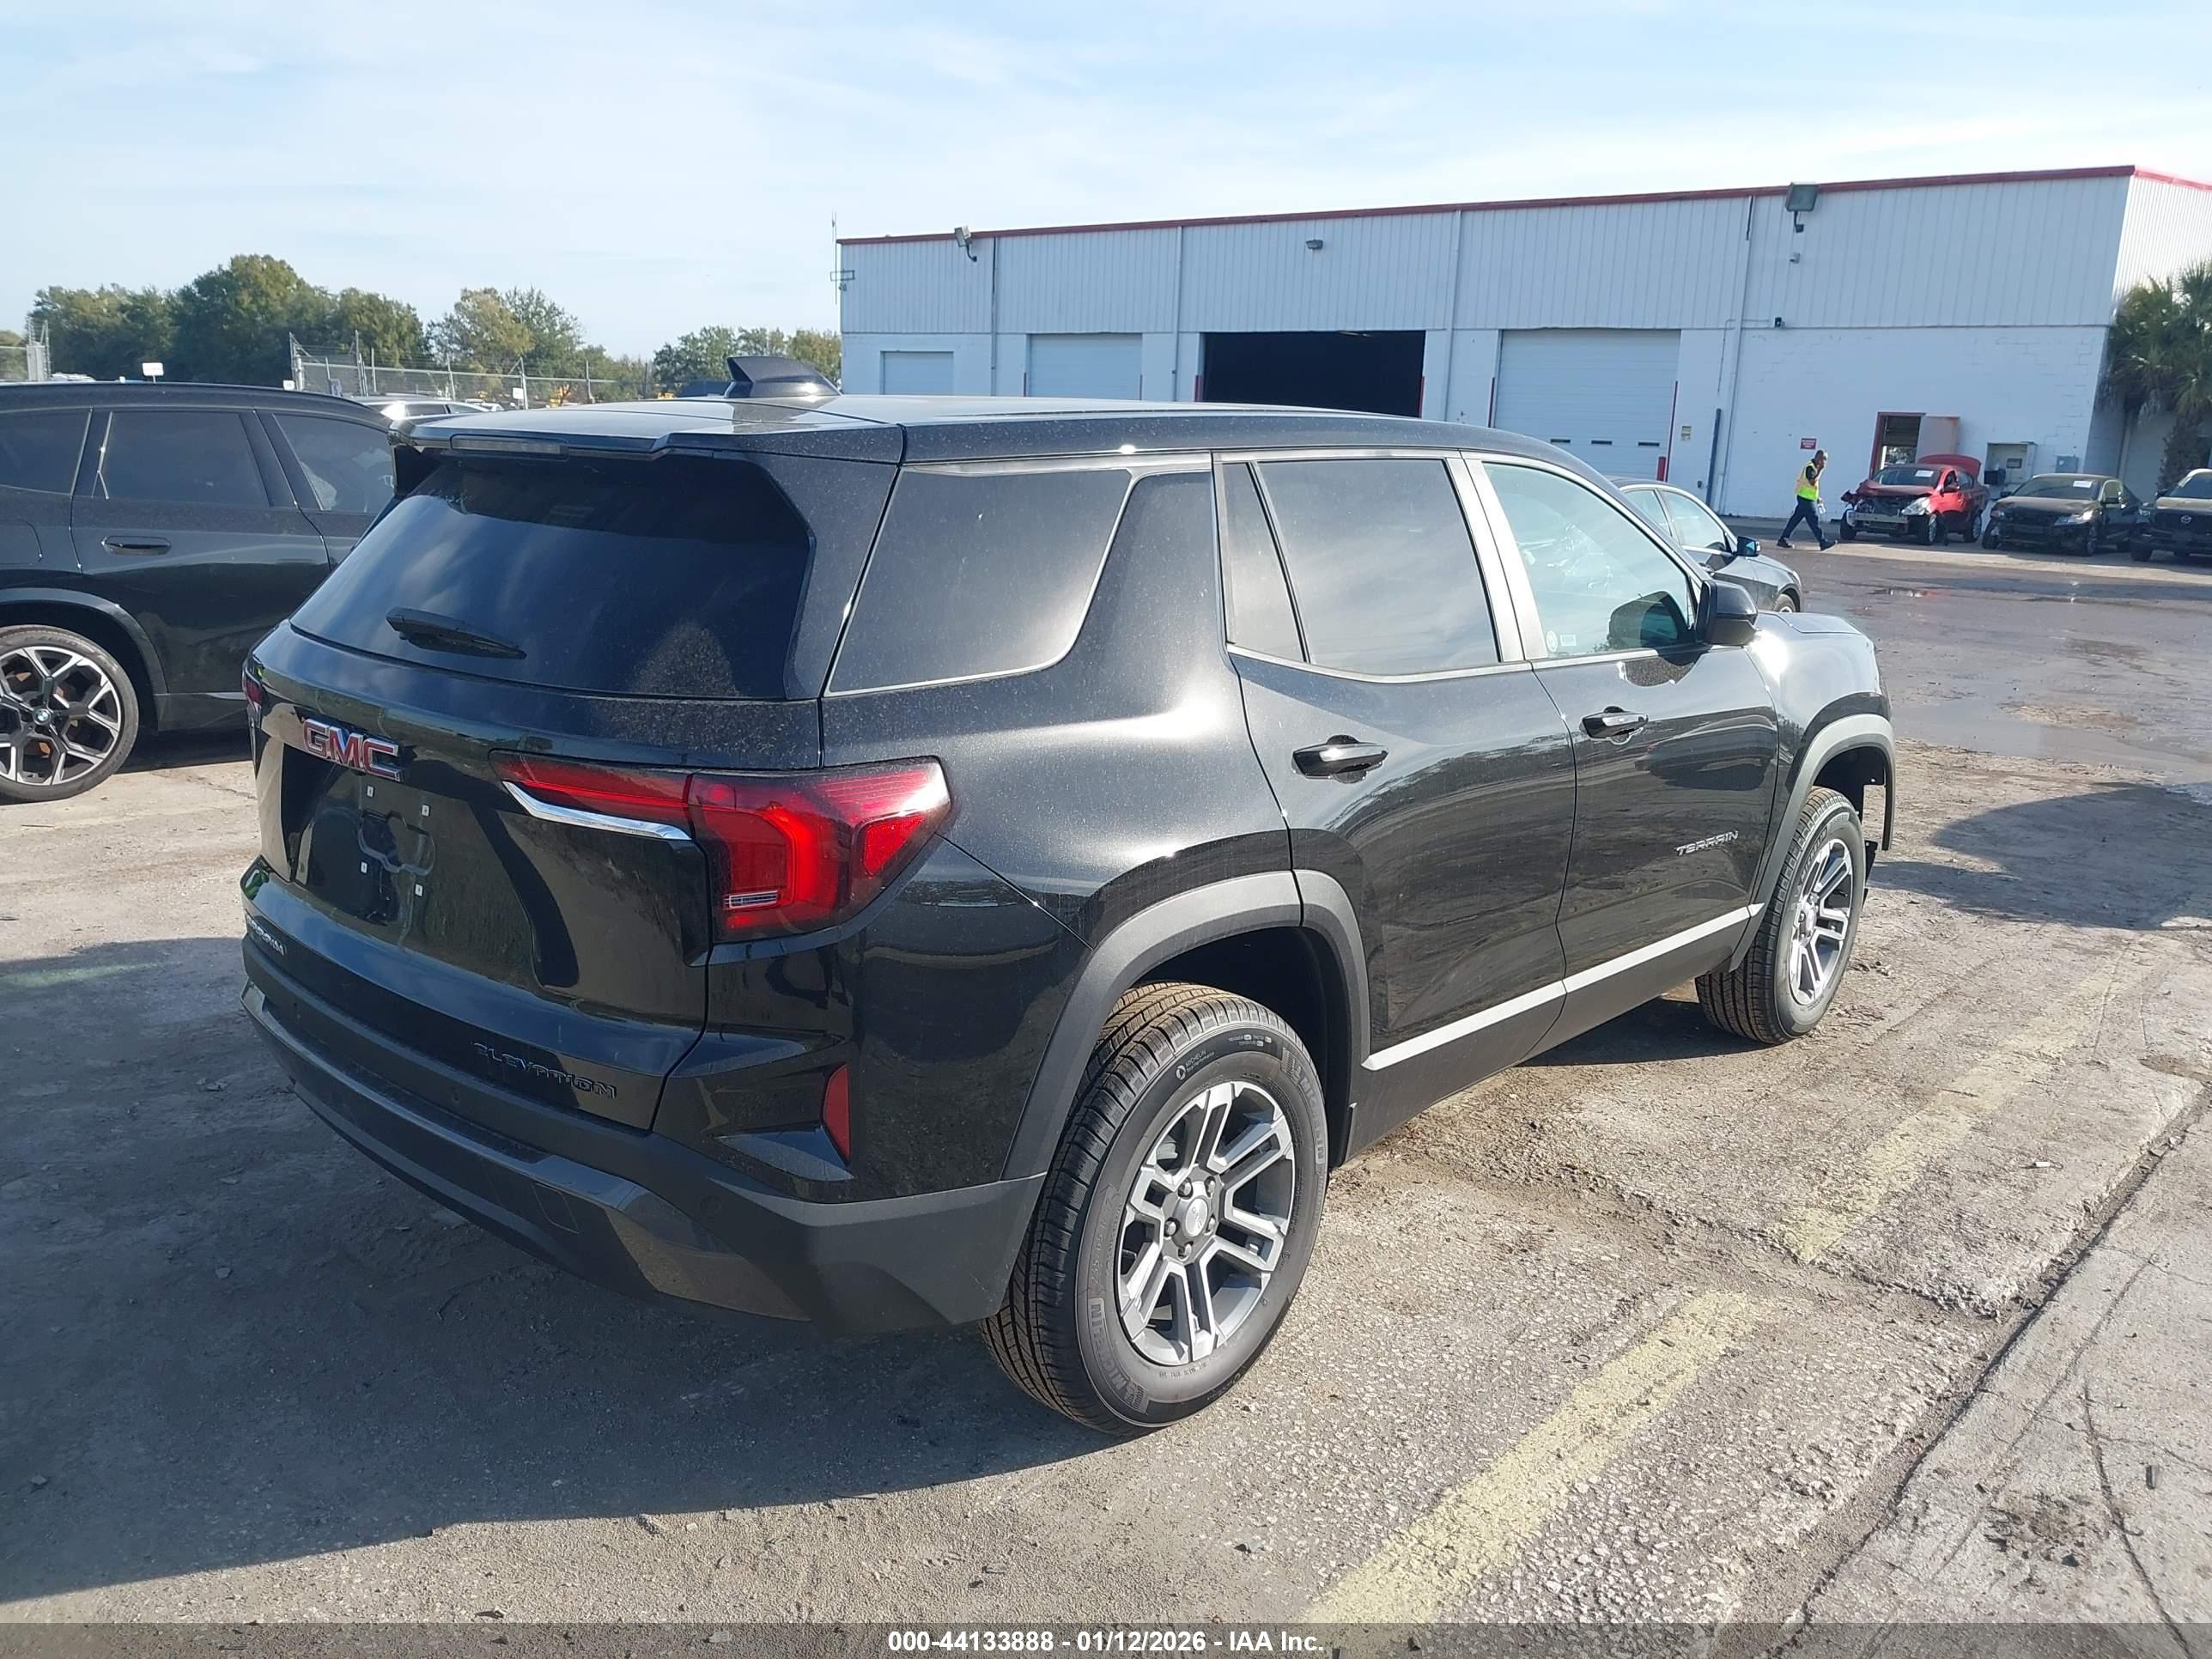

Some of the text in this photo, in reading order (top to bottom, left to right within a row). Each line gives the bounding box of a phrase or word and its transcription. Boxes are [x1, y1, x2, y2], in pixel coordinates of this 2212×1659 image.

[302, 718, 401, 782] GMC
[1675, 830, 1739, 857] TERRAIN
[473, 1042, 617, 1100] ELEVATION
